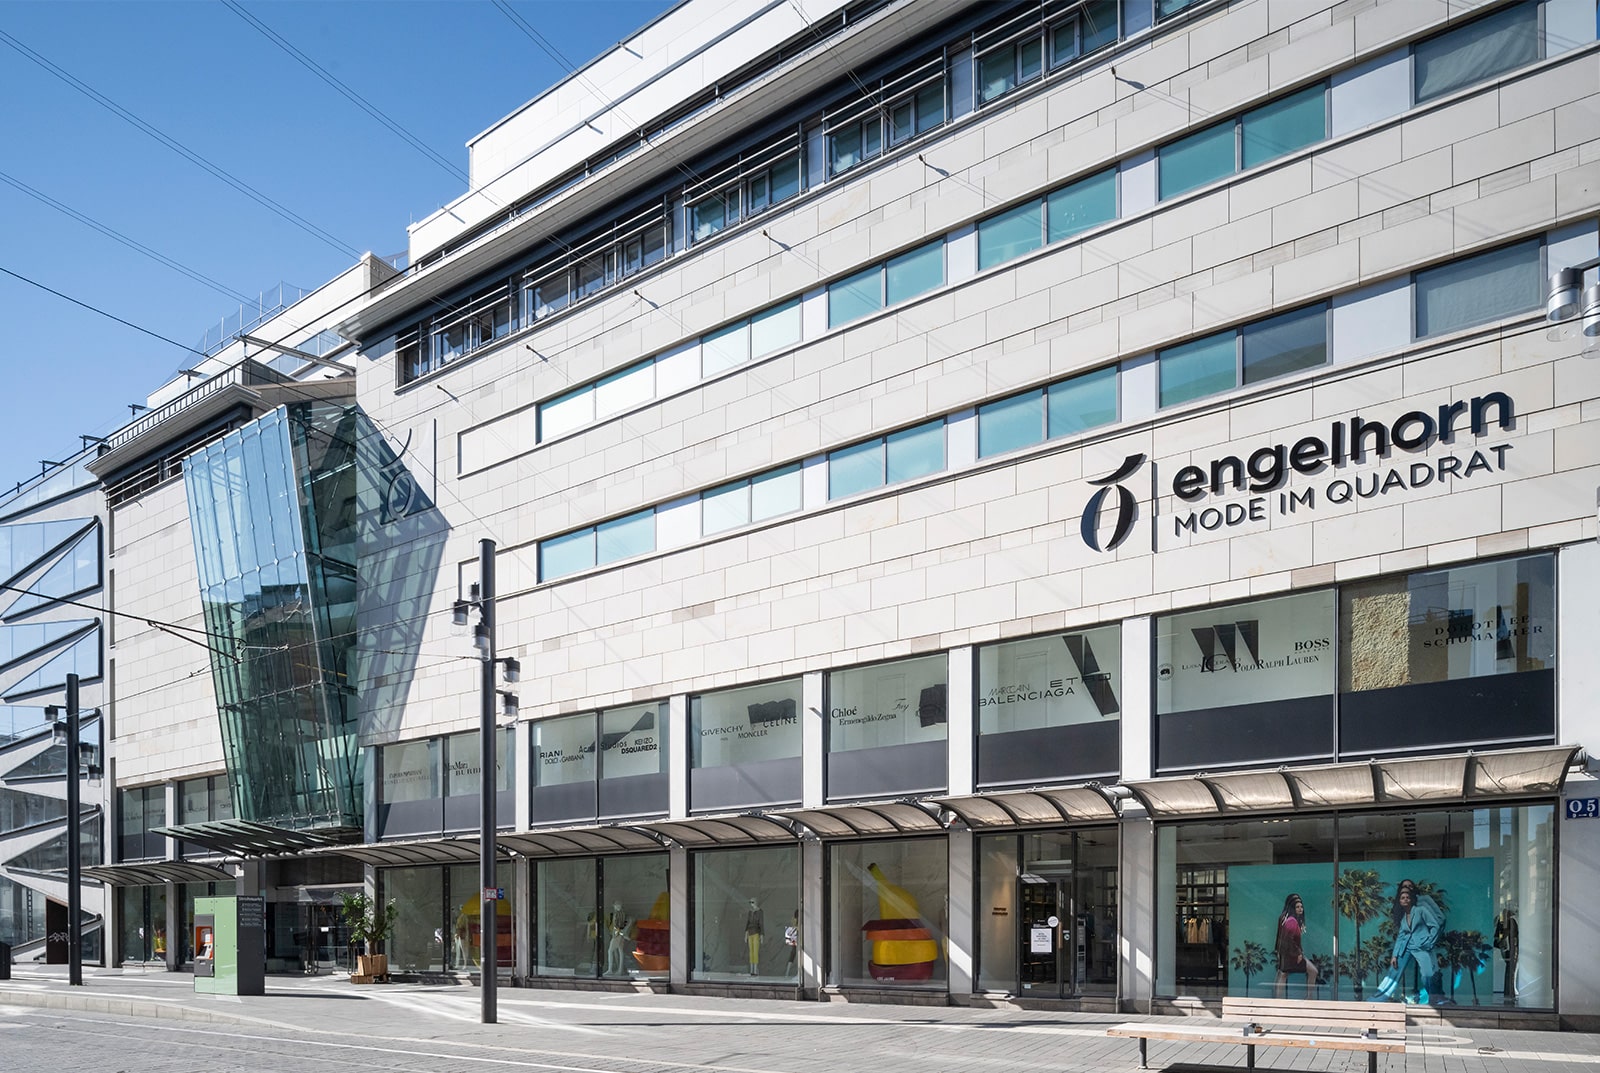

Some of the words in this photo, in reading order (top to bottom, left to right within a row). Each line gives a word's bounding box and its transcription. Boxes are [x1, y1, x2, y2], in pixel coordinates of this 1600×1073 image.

[1172, 391, 1513, 501] engelhorn
[1174, 498, 1266, 537] MODE
[1280, 486, 1315, 516] IM
[1326, 443, 1513, 504] QUADRAT
[1294, 637, 1330, 651] BOSS
[978, 687, 1075, 708] BALENCIAGA
[831, 705, 858, 719] Chloé
[700, 724, 745, 737] GIVENCHY
[737, 729, 769, 739] MONCLER
[539, 749, 564, 760] RIANI
[620, 743, 658, 755] DSQUARED2
[1569, 800, 1583, 813] O
[1586, 799, 1596, 812] 5
